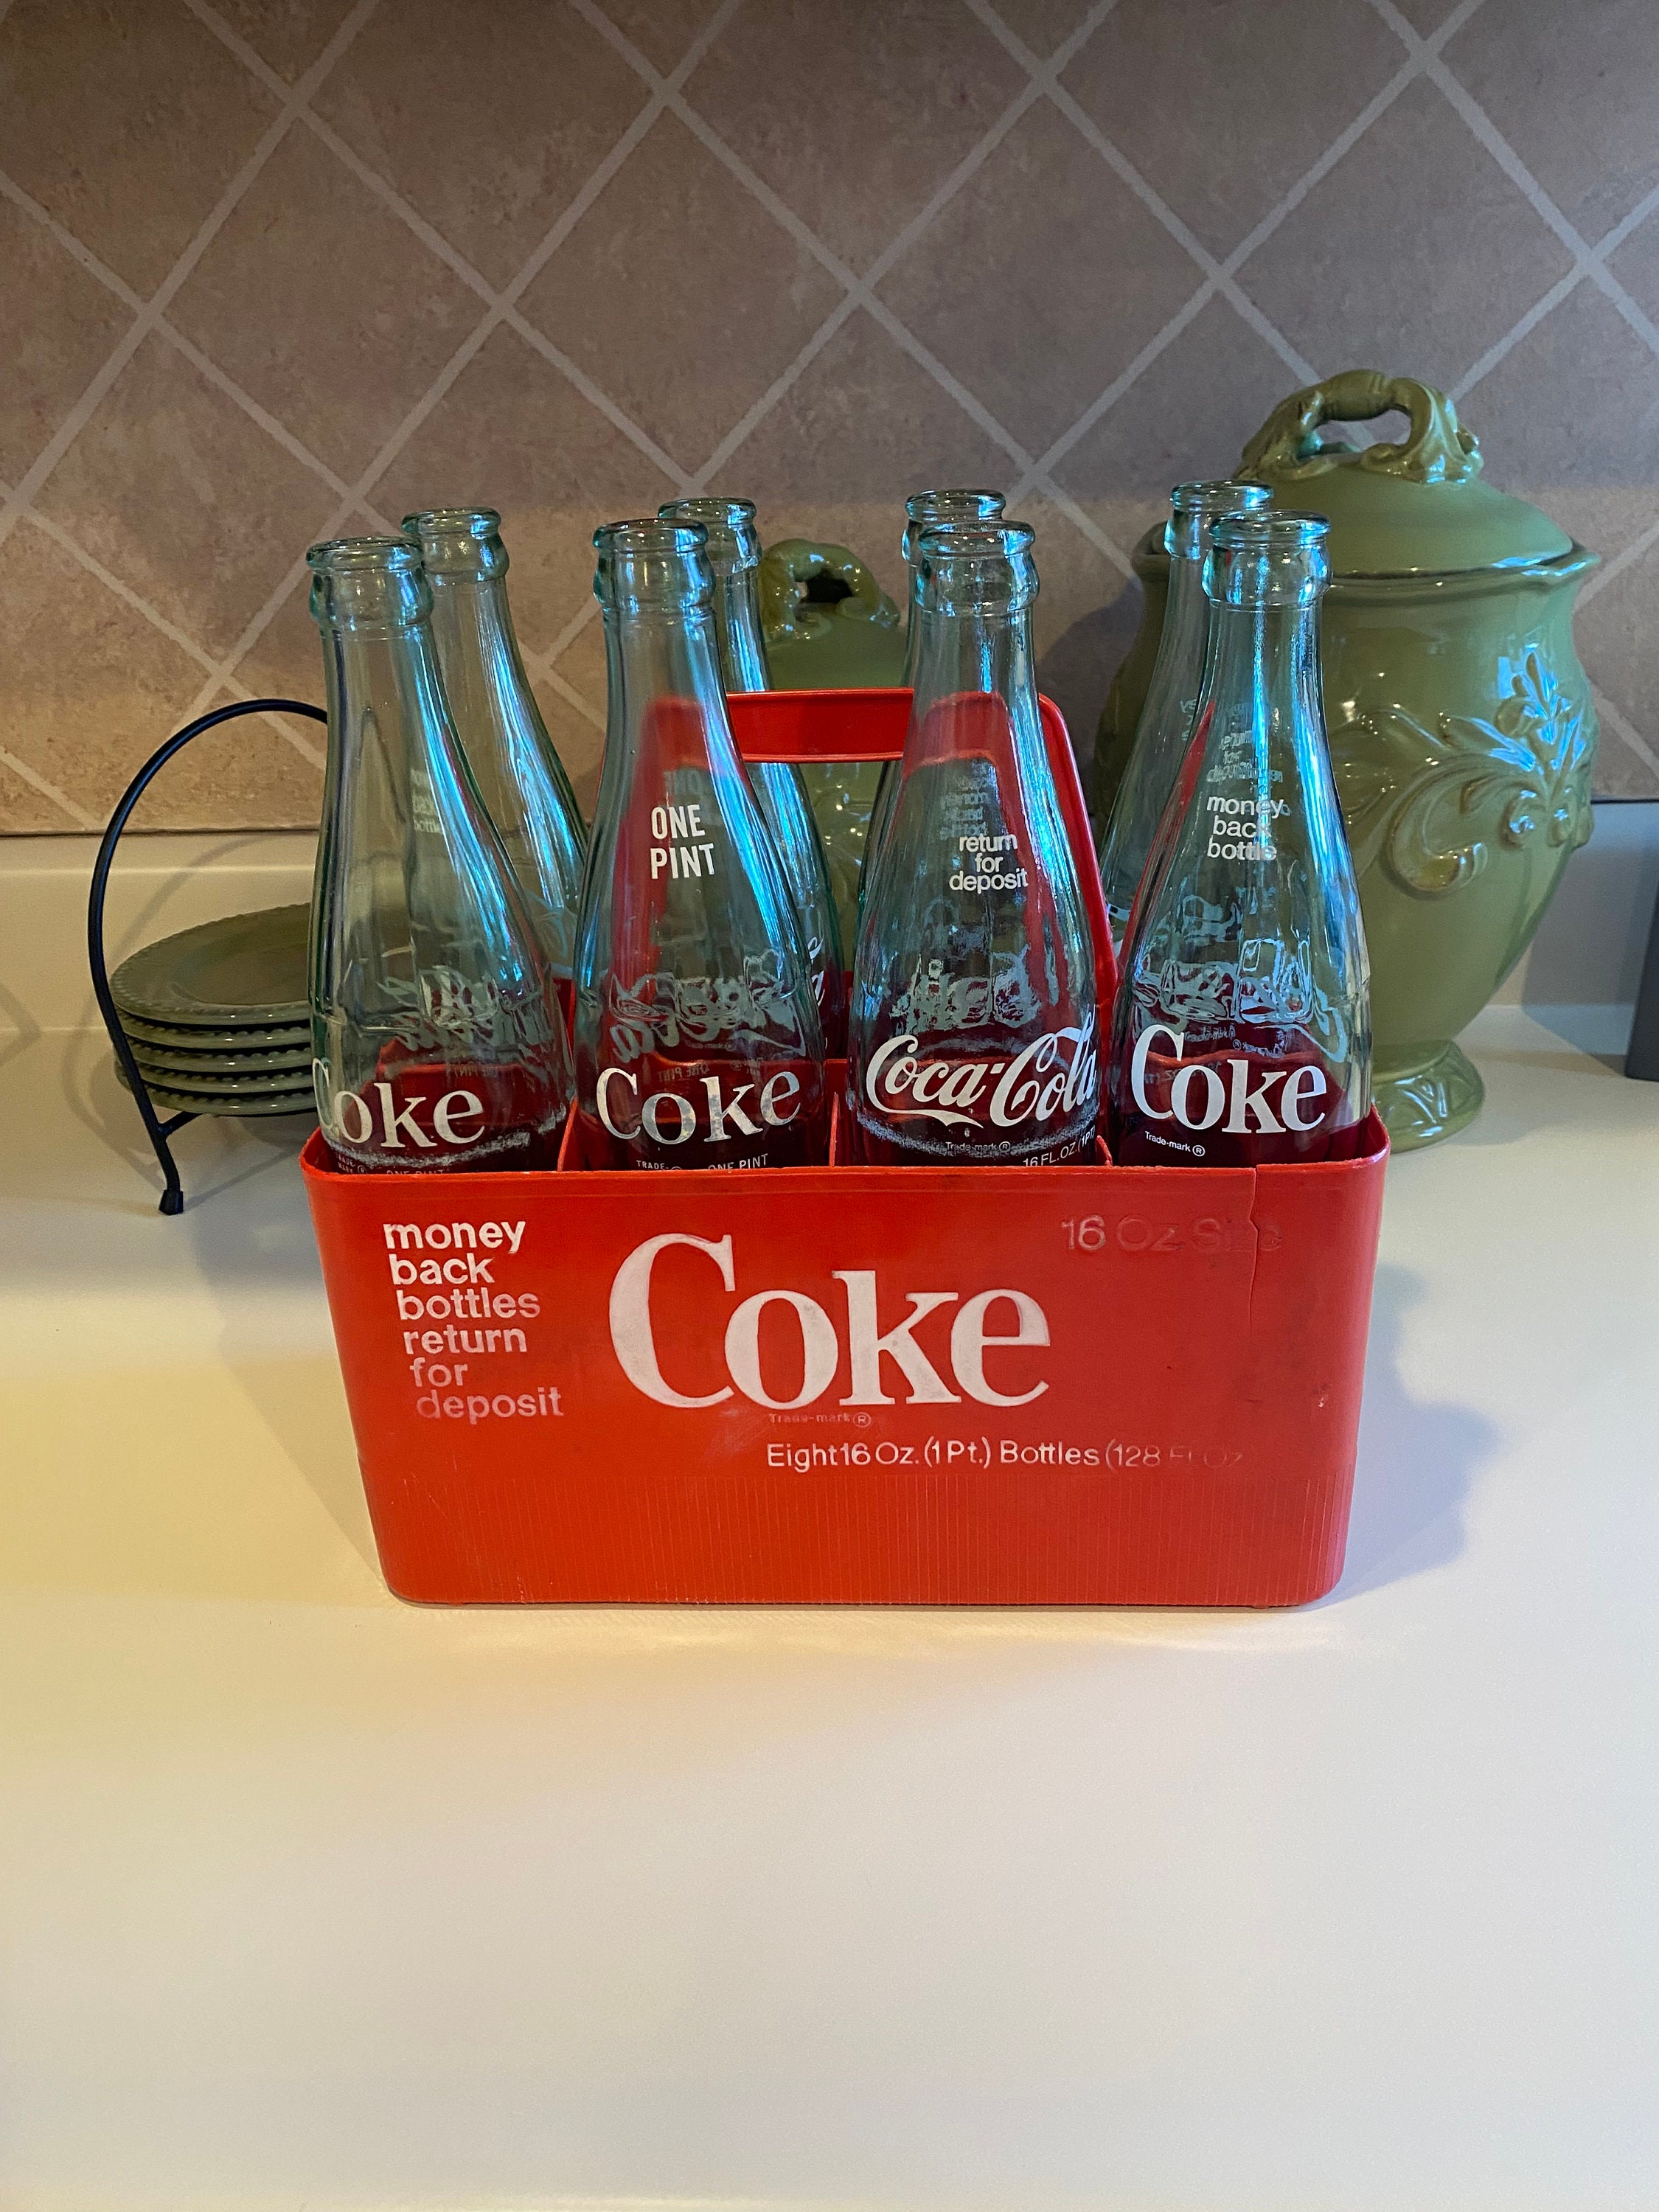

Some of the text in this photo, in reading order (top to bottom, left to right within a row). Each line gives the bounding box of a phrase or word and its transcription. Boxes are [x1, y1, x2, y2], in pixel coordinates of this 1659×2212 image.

[651, 804, 706, 840] ONE
[1206, 796, 1284, 819] money
[959, 833, 1018, 852] return
[1212, 815, 1272, 838] back
[650, 843, 715, 880] PINT
[974, 852, 1004, 874] for
[1206, 835, 1277, 861] bottle
[948, 868, 1029, 894] deposit
[866, 1003, 1098, 1128] Coca-Cola
[1131, 1024, 1326, 1134] Coke
[596, 1067, 801, 1145] Coke
[739, 1152, 769, 1169] PINT
[383, 1220, 526, 1253] money
[1061, 1214, 1106, 1251] 16
[389, 1253, 495, 1285] back
[396, 1288, 541, 1321] bottles
[608, 1233, 1051, 1410] Coke
[403, 1325, 528, 1355] return
[409, 1357, 468, 1388] for
[416, 1387, 564, 1425] deposit
[767, 1442, 838, 1473] Eight
[875, 1441, 919, 1465] Oz.
[999, 1439, 1100, 1466] Bottles
[1105, 1438, 1161, 1473] (128
